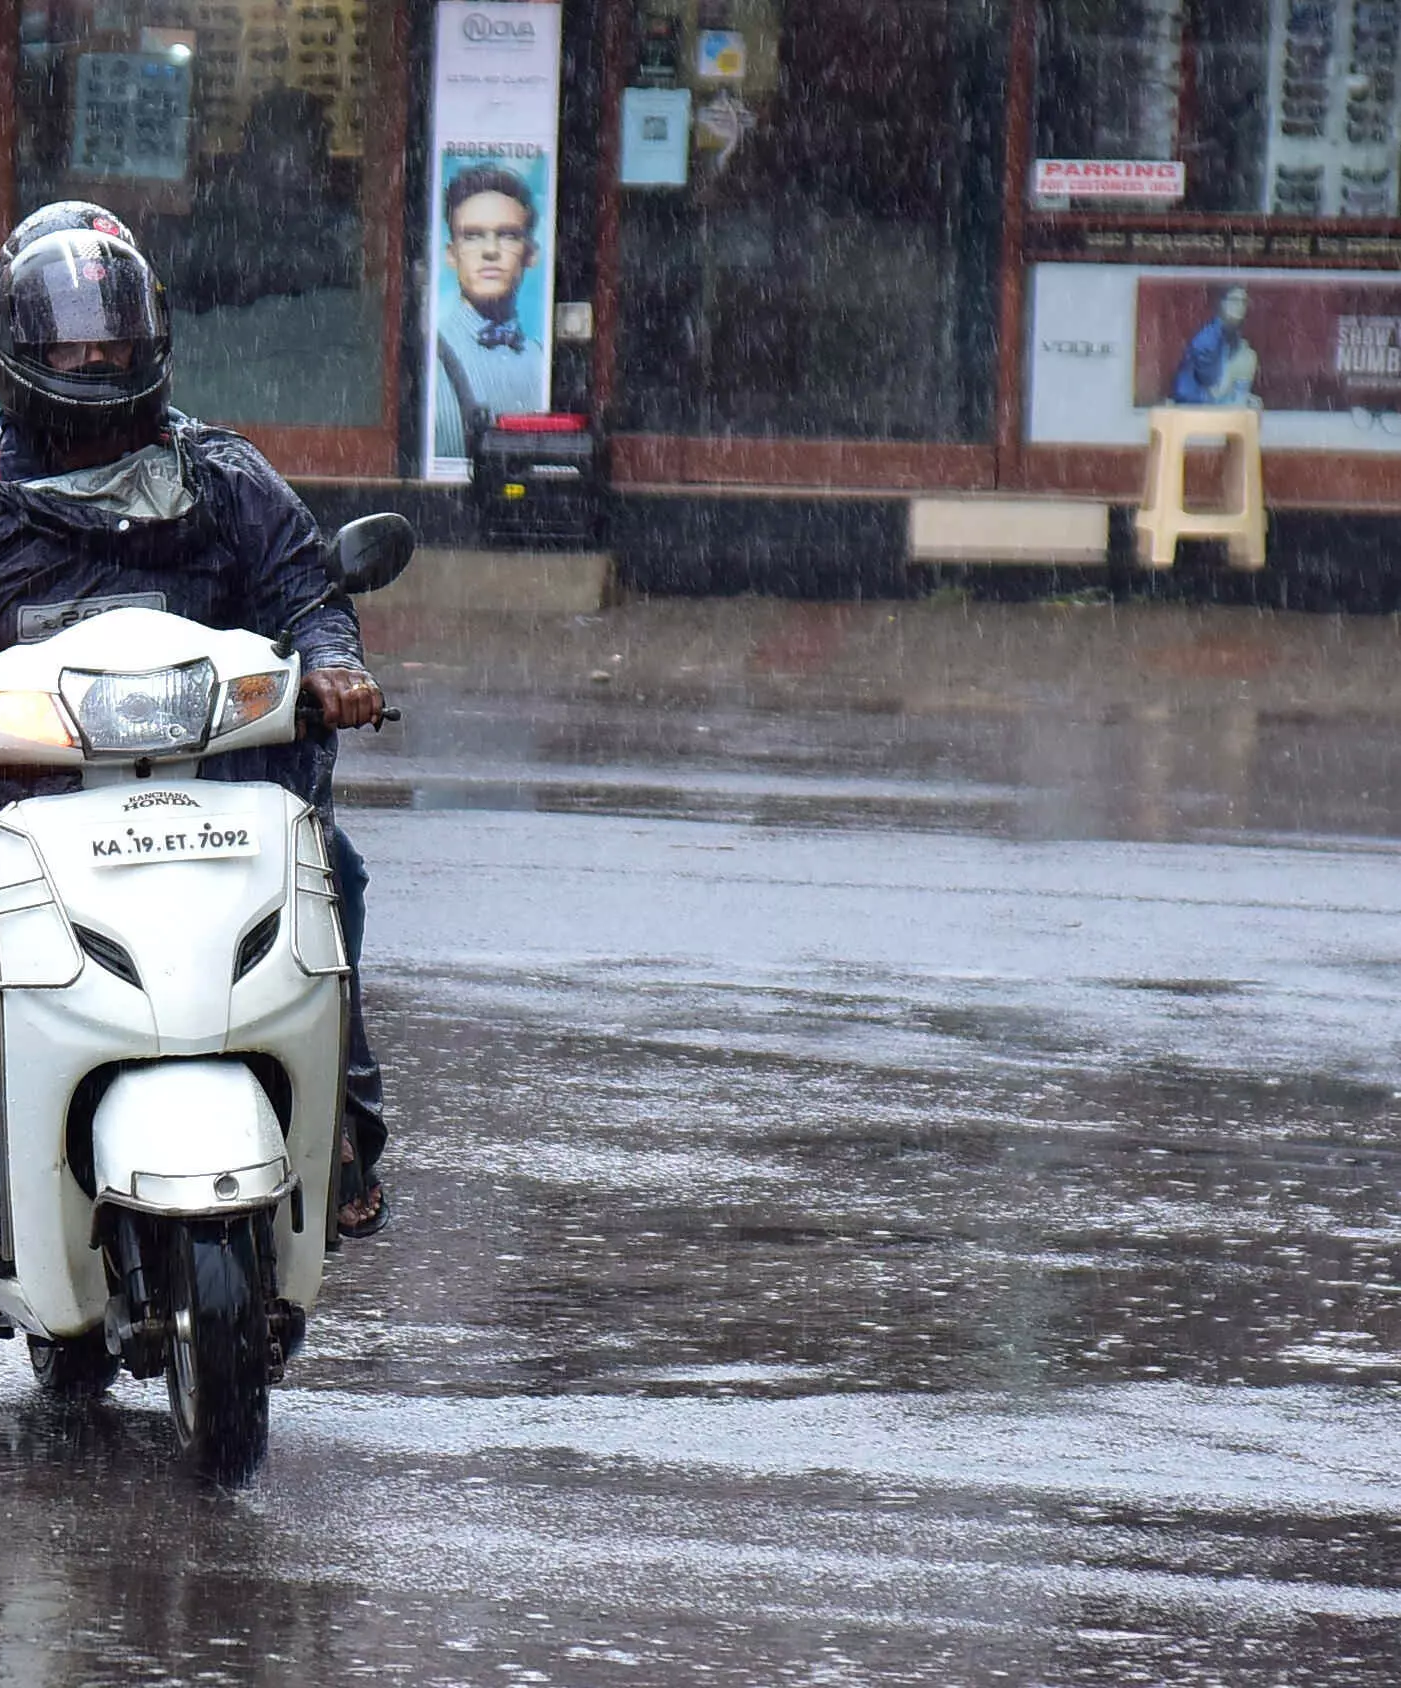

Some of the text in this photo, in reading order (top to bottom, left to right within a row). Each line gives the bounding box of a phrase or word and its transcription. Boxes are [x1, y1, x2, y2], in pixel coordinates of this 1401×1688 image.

[463, 13, 536, 41] NOVA
[446, 141, 544, 159] RODENSTOCK
[1044, 162, 1177, 178] PARKING
[122, 798, 203, 812] HONDA
[128, 791, 190, 803] KANCHANA
